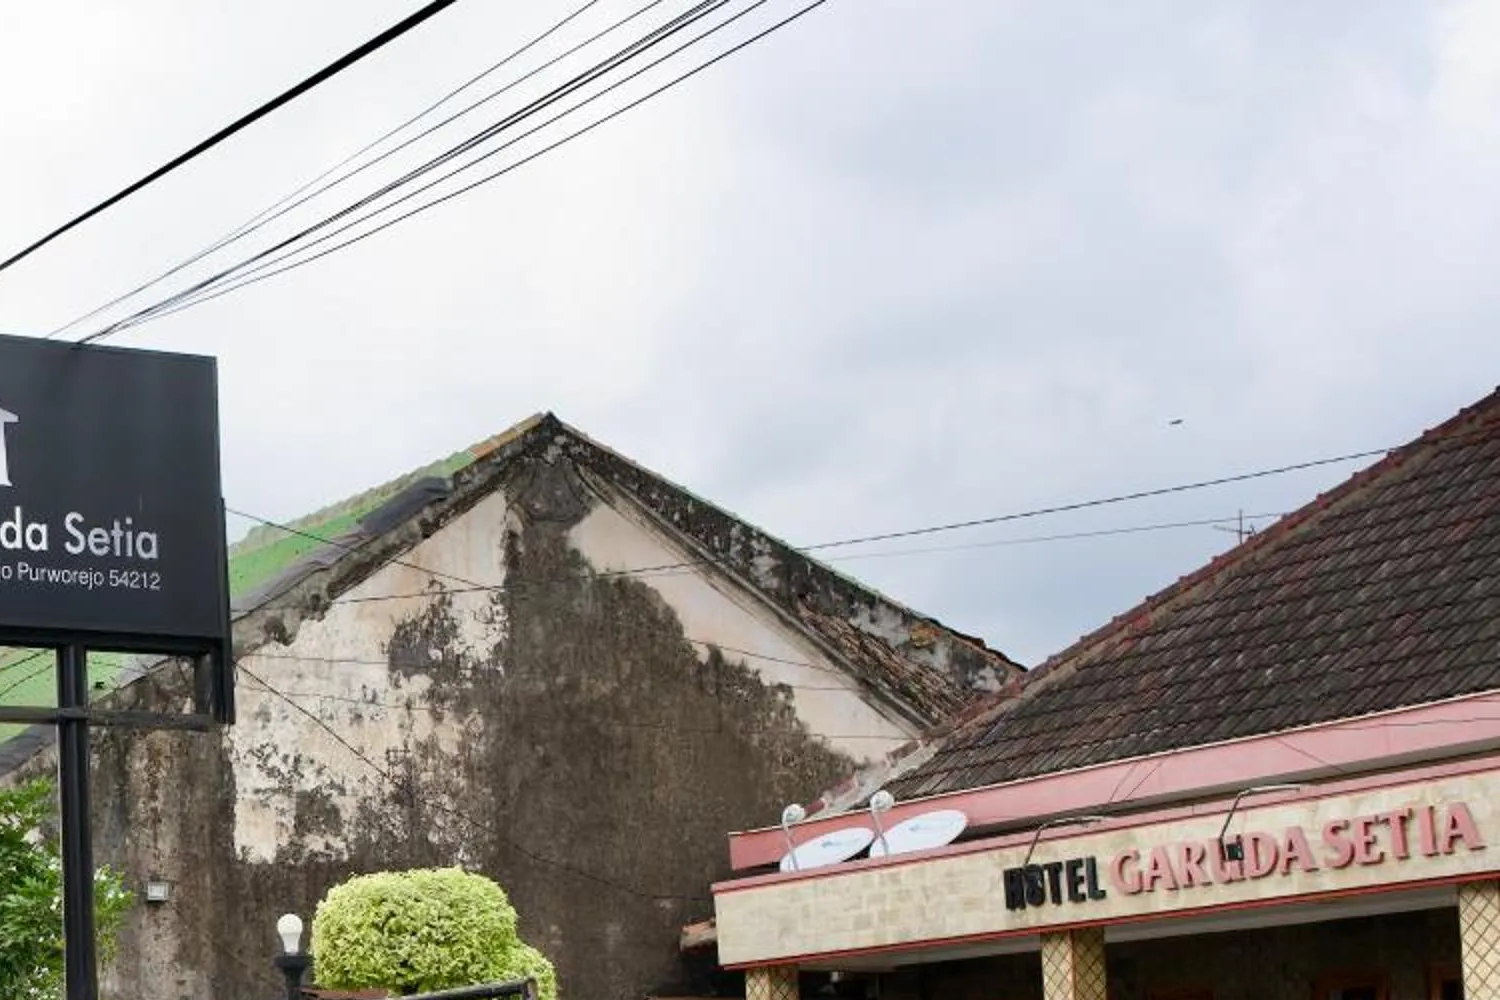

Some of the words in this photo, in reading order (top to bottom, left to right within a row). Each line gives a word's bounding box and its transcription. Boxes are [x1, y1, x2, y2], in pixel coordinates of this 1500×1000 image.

[64, 511, 159, 559] Setia
[17, 561, 104, 590] Purworejo
[109, 569, 161, 590] 54212
[1003, 856, 1107, 911] HOTEL
[1322, 801, 1487, 870] SETIA
